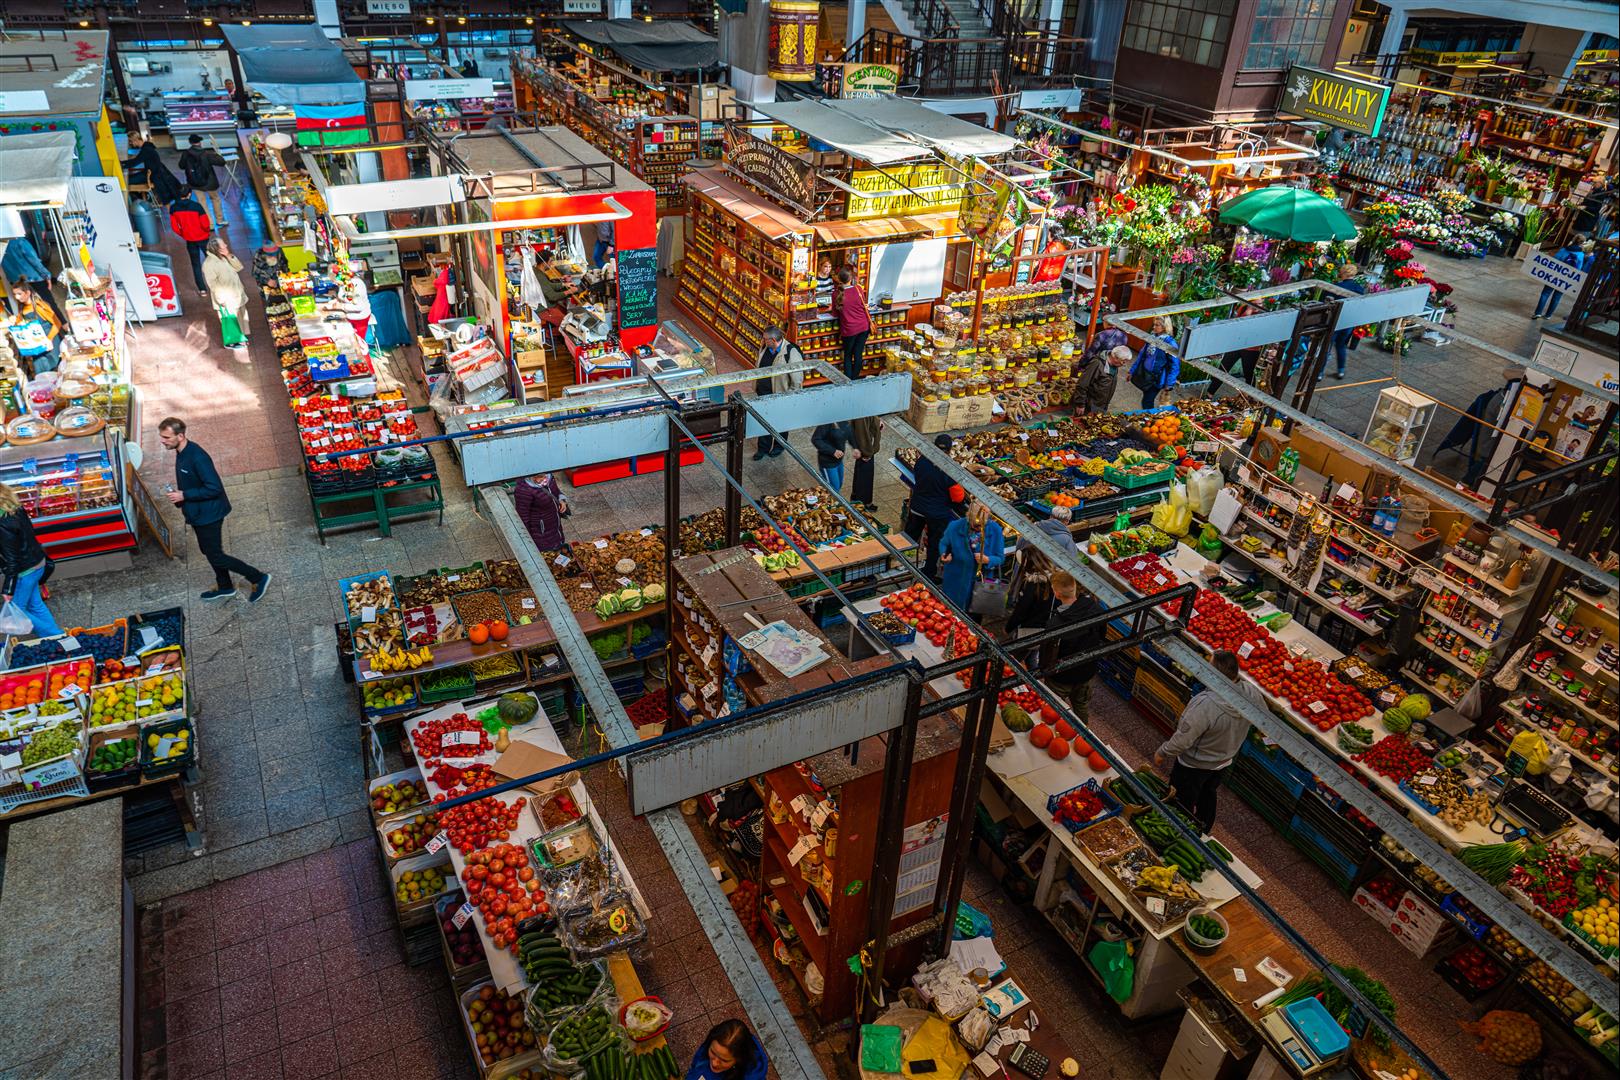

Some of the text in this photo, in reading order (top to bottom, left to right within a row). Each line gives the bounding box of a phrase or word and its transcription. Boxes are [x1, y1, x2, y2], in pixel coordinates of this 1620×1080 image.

[1308, 78, 1378, 118] KWIATY
[727, 141, 757, 161] CENTRUM
[757, 142, 778, 157] KAWY
[737, 152, 772, 166] PRZYPRAWY
[851, 198, 867, 214] BEZ
[1531, 267, 1573, 290] LOKATY
[1533, 255, 1581, 282] AGENCJA
